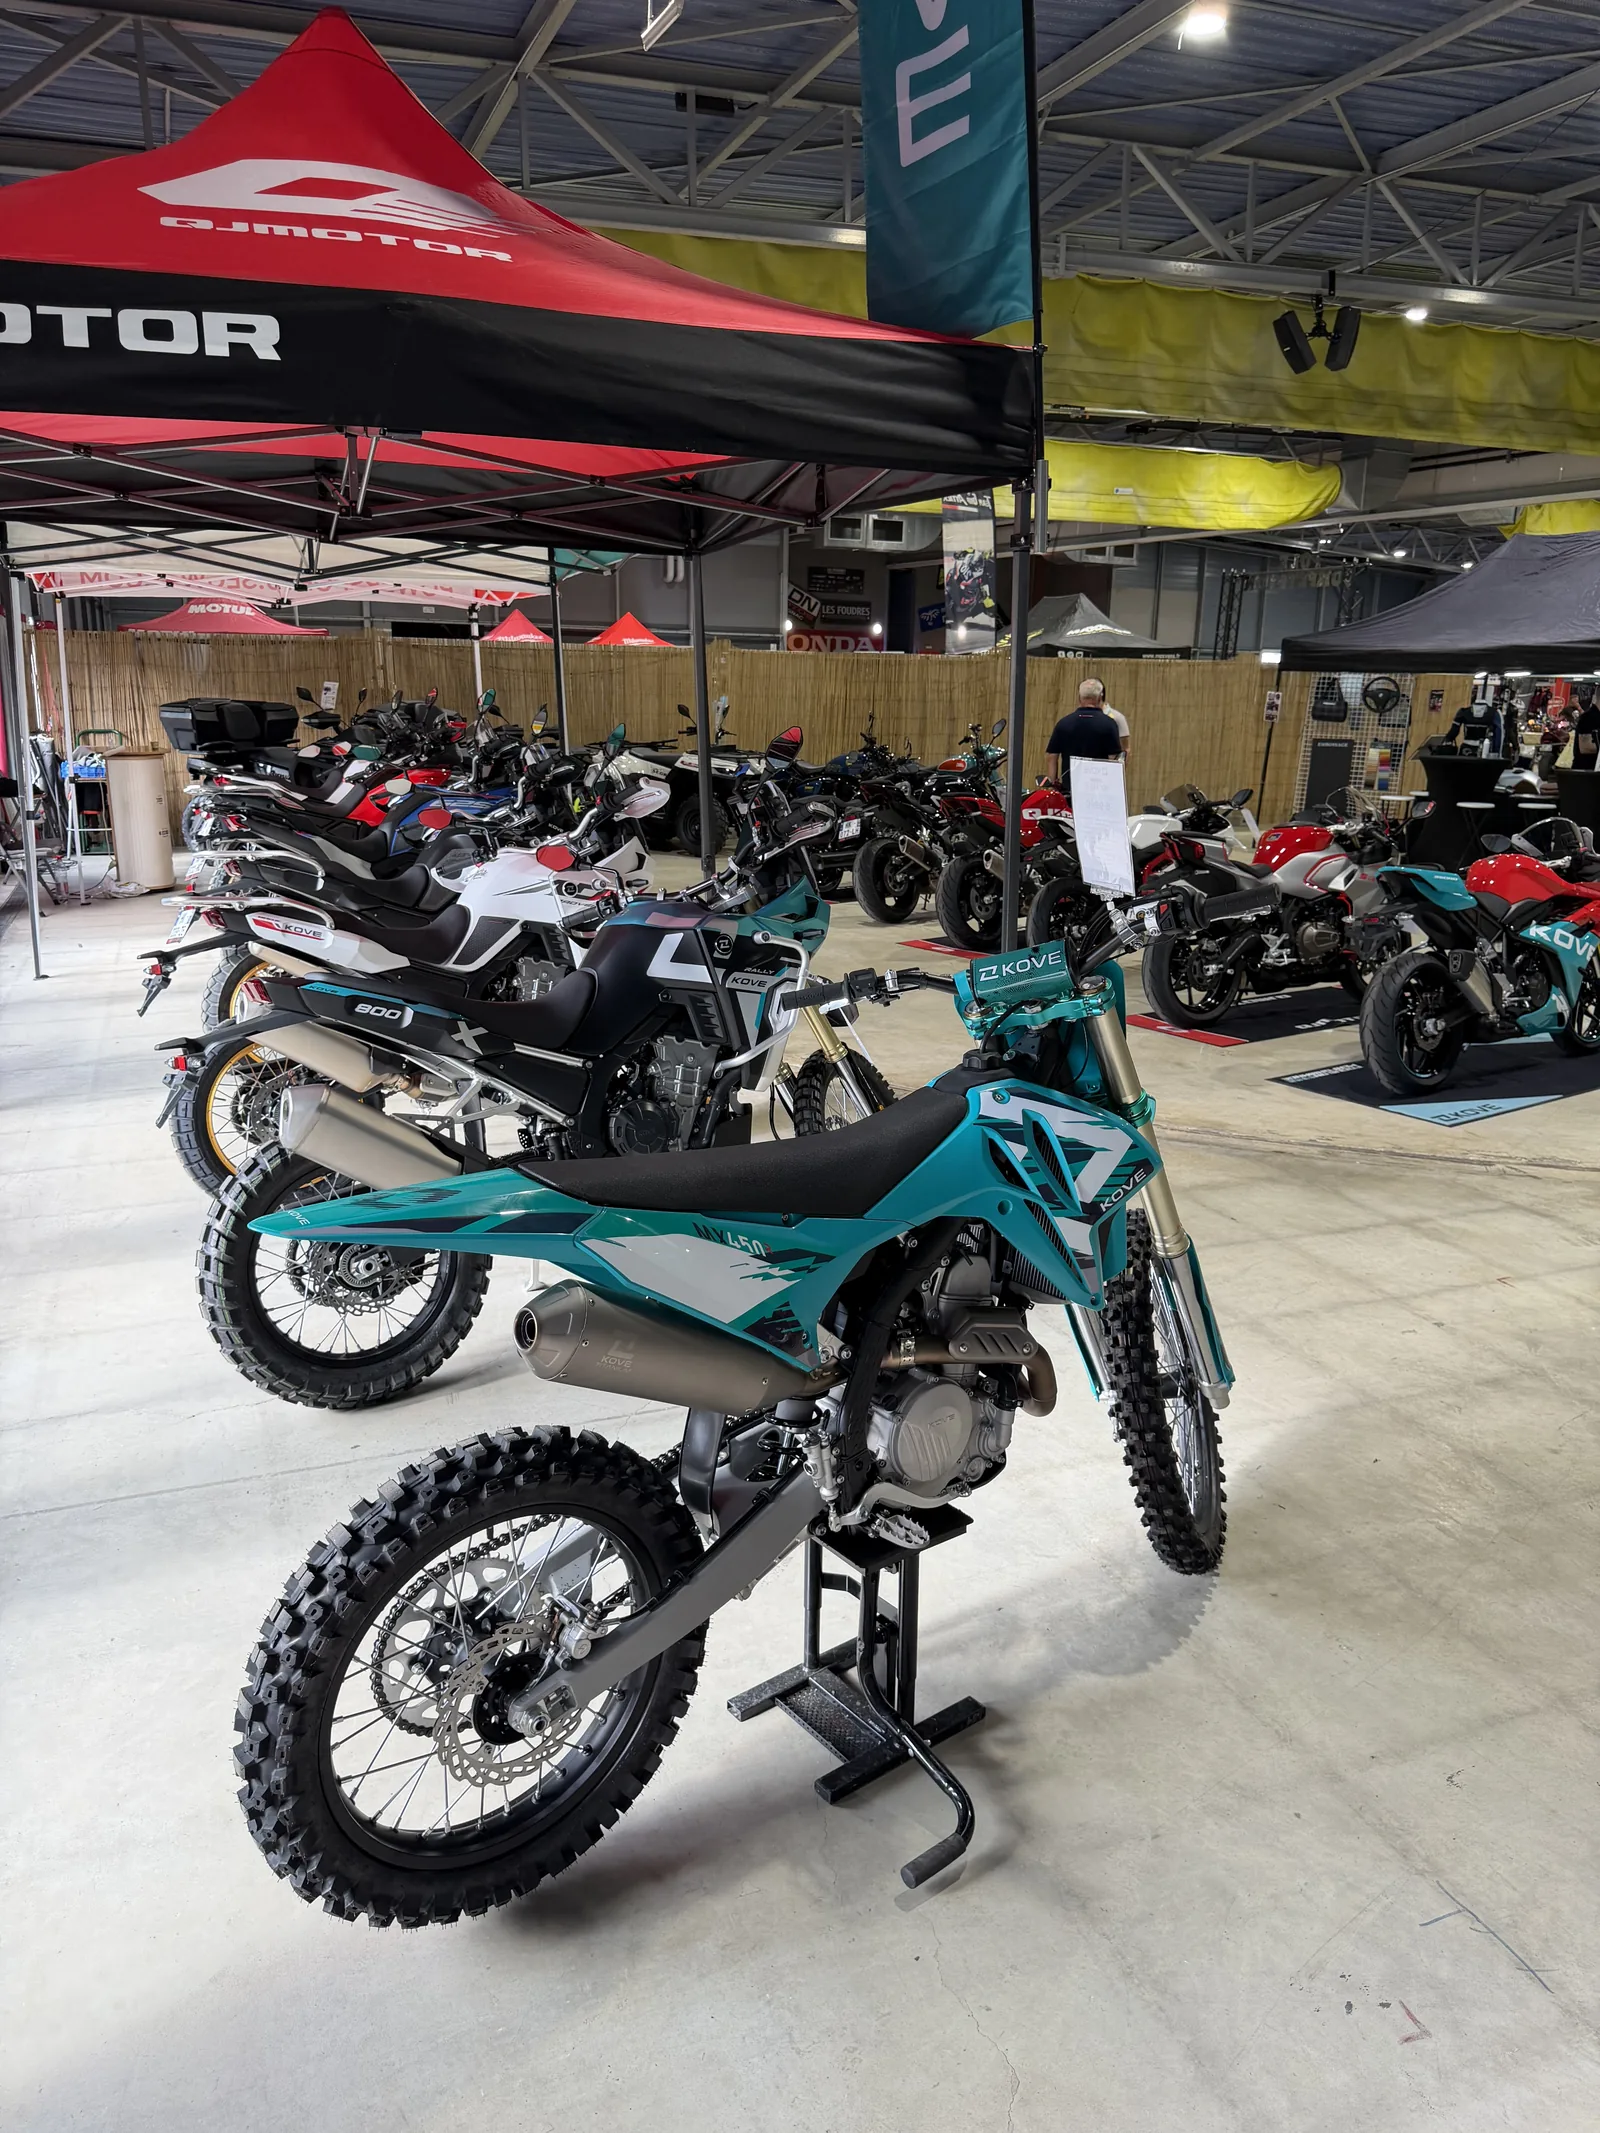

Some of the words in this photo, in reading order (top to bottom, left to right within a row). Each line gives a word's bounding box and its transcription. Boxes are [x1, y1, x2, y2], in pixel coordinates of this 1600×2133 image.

[160, 216, 513, 263] QJMOTOR
[188, 603, 256, 616] MOTUL
[822, 605, 835, 614] LES
[837, 606, 871, 616] FOUDRES
[787, 634, 876, 652] ONDA
[284, 924, 323, 937] KOVE
[1001, 950, 1063, 976] KOVE
[744, 967, 775, 975] RALLY
[308, 985, 339, 994] KOVE
[731, 976, 767, 988] KOVE
[354, 1003, 402, 1020] 800
[451, 1020, 489, 1055] X
[1448, 1103, 1503, 1120] KOVE
[1099, 1168, 1147, 1212] KOVE
[601, 1355, 633, 1368] KOVE
